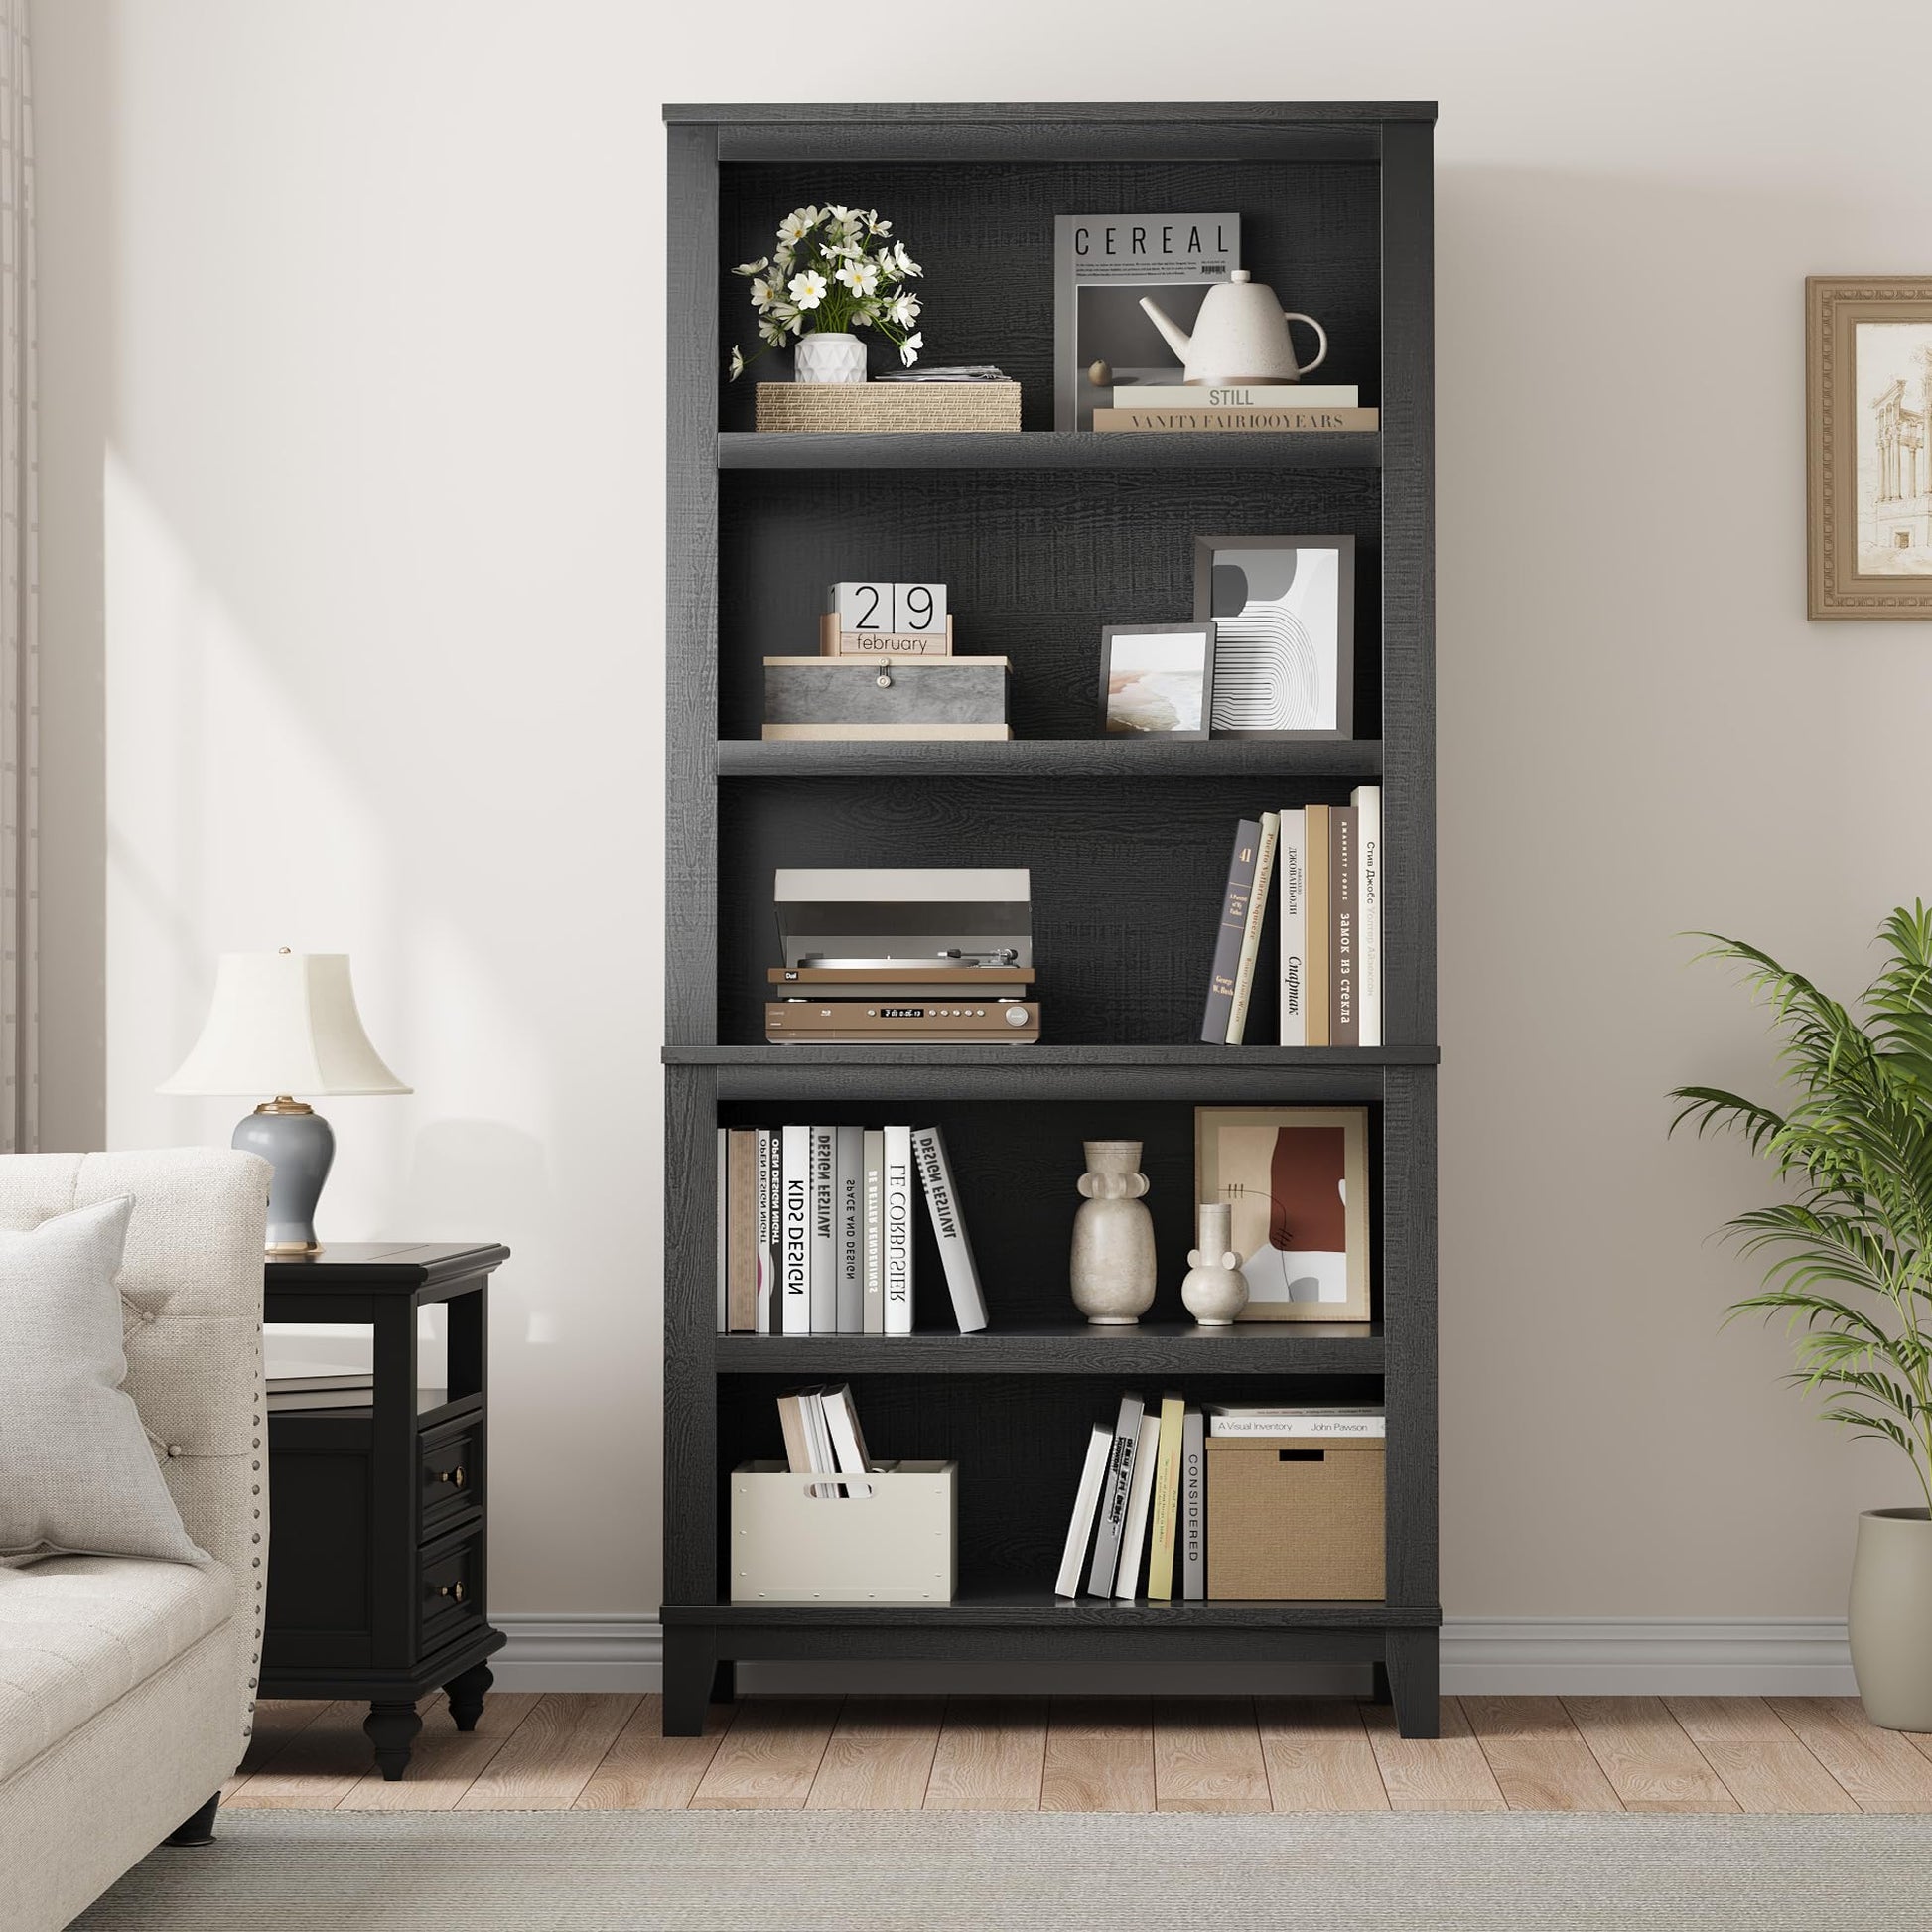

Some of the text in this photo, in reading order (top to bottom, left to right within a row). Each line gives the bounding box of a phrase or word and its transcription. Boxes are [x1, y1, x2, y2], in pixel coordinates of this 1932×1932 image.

[1075, 225, 1230, 256] CEREAL
[1209, 389, 1254, 406] STILL
[1132, 415, 1198, 429] VANITY
[1204, 415, 1246, 429] FAIR
[1279, 414, 1343, 428] YEARS
[857, 633, 928, 655] february
[1289, 847, 1298, 915] ДЖОВАНЬОЛИ
[1366, 869, 1376, 904] Джобс
[1340, 913, 1350, 1024] замок из стекла
[1285, 956, 1302, 1016] Спартак
[1218, 1422, 1292, 1433] A Visual Inventory
[1311, 1423, 1368, 1432] John Pawson
[1188, 1454, 1198, 1562] CONSIDERED
